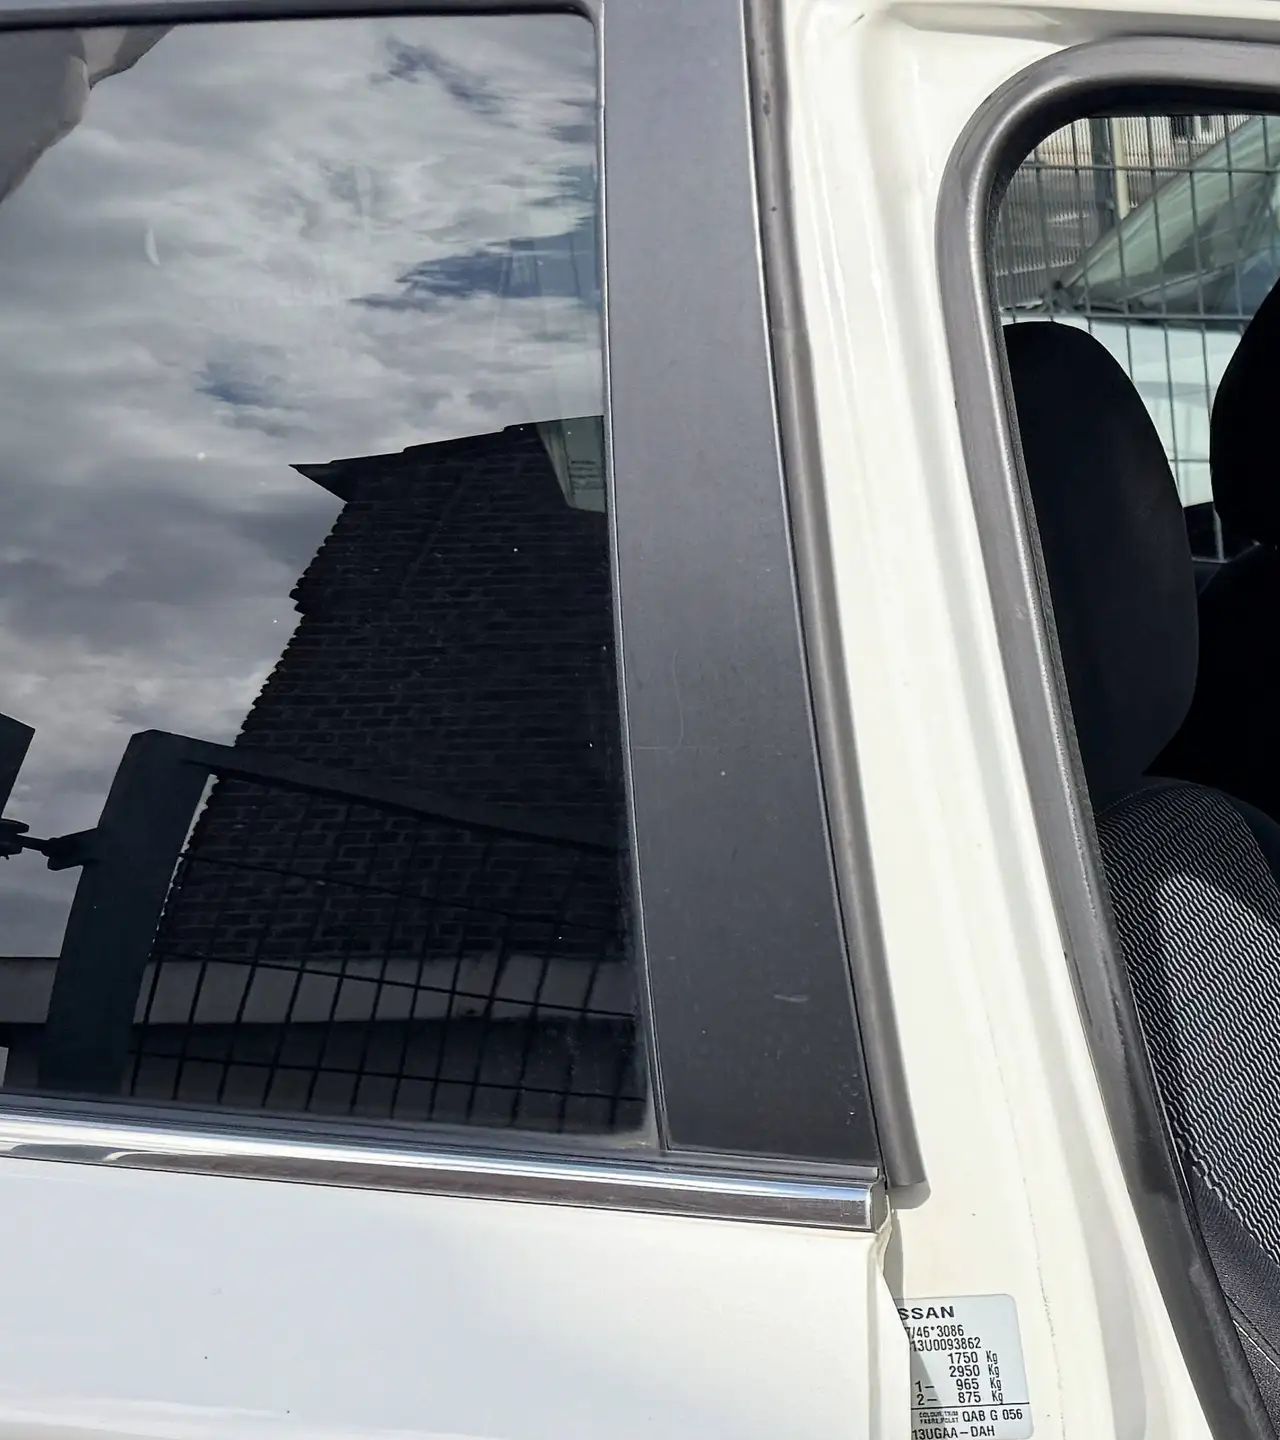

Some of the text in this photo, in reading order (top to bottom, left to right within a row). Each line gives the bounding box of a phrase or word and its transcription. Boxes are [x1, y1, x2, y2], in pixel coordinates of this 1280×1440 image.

[947, 1350, 998, 1365] 1750 Kg
[949, 1364, 1000, 1378] 2950 Kg
[956, 1378, 980, 1391] 965
[989, 1377, 1002, 1391] Kg
[957, 1391, 981, 1404] 875
[991, 1391, 1004, 1405] Kg
[962, 1410, 986, 1423] QAB
[990, 1410, 999, 1421] G
[1002, 1409, 1023, 1421] 056
